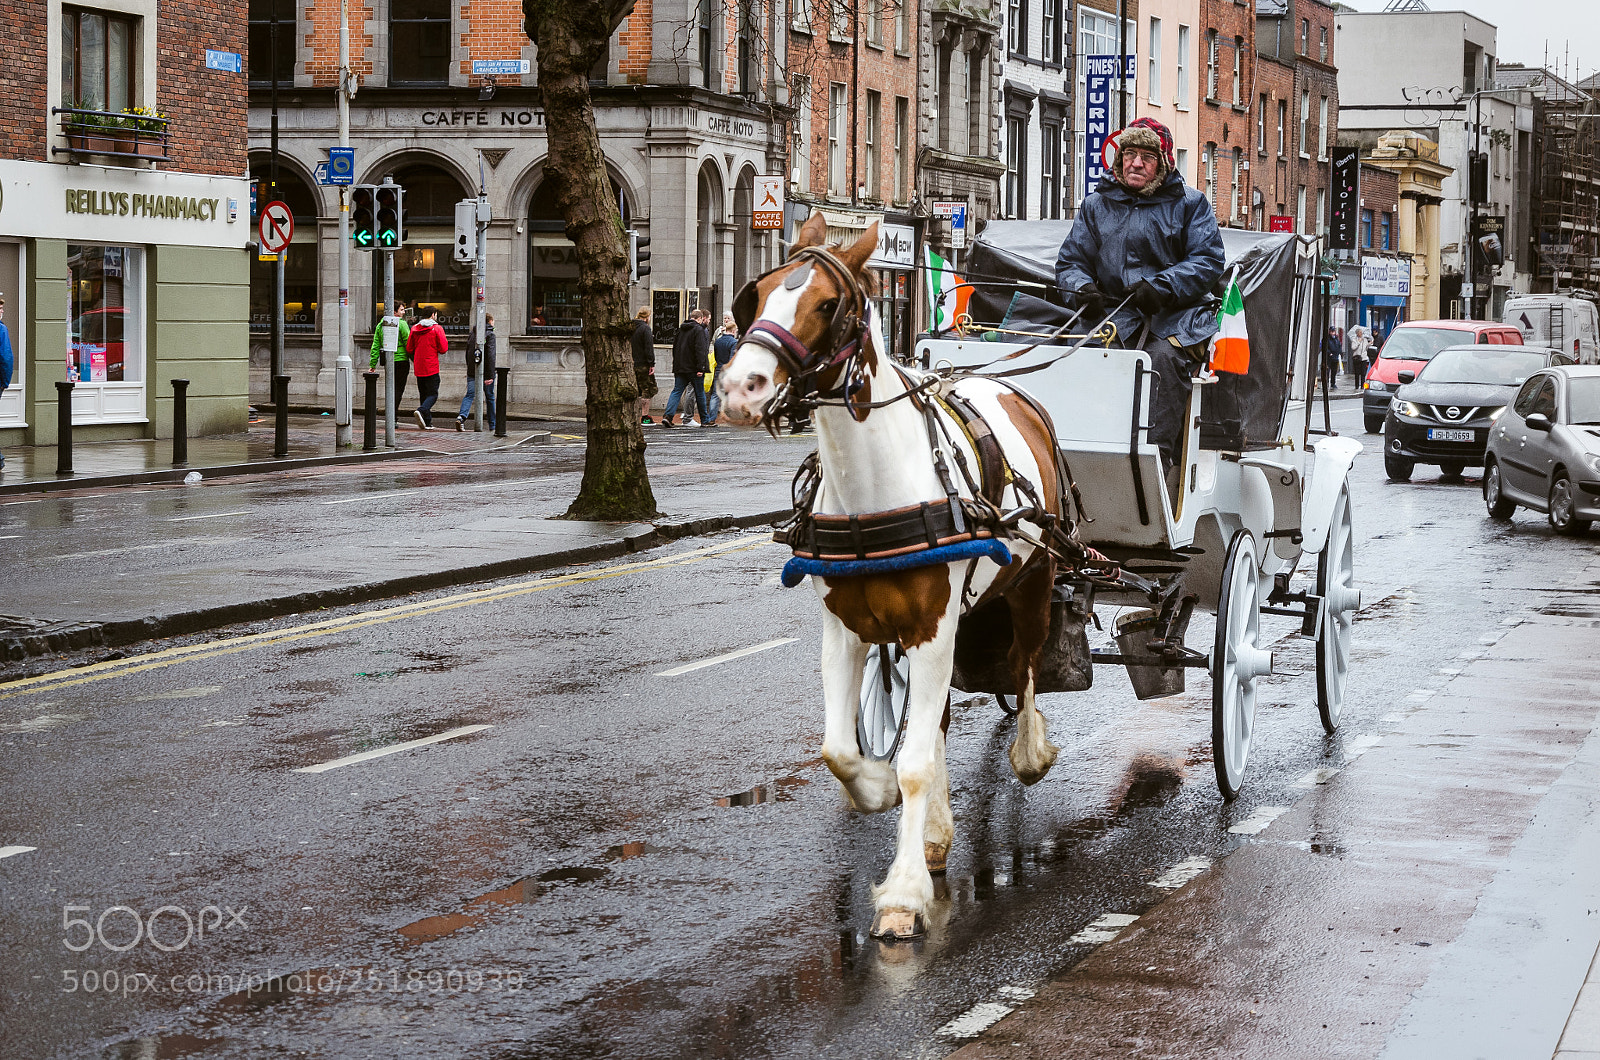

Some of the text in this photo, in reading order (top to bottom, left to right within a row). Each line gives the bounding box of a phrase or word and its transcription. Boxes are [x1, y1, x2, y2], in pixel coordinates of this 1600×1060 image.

[421, 107, 546, 126] CAFFÉ NOT
[733, 121, 754, 137] NOTO
[1088, 77, 1106, 194] FURNITU
[66, 188, 220, 222] REILLYS PHARMACY
[754, 212, 781, 220] CAFFÉ
[1339, 168, 1349, 241] florist
